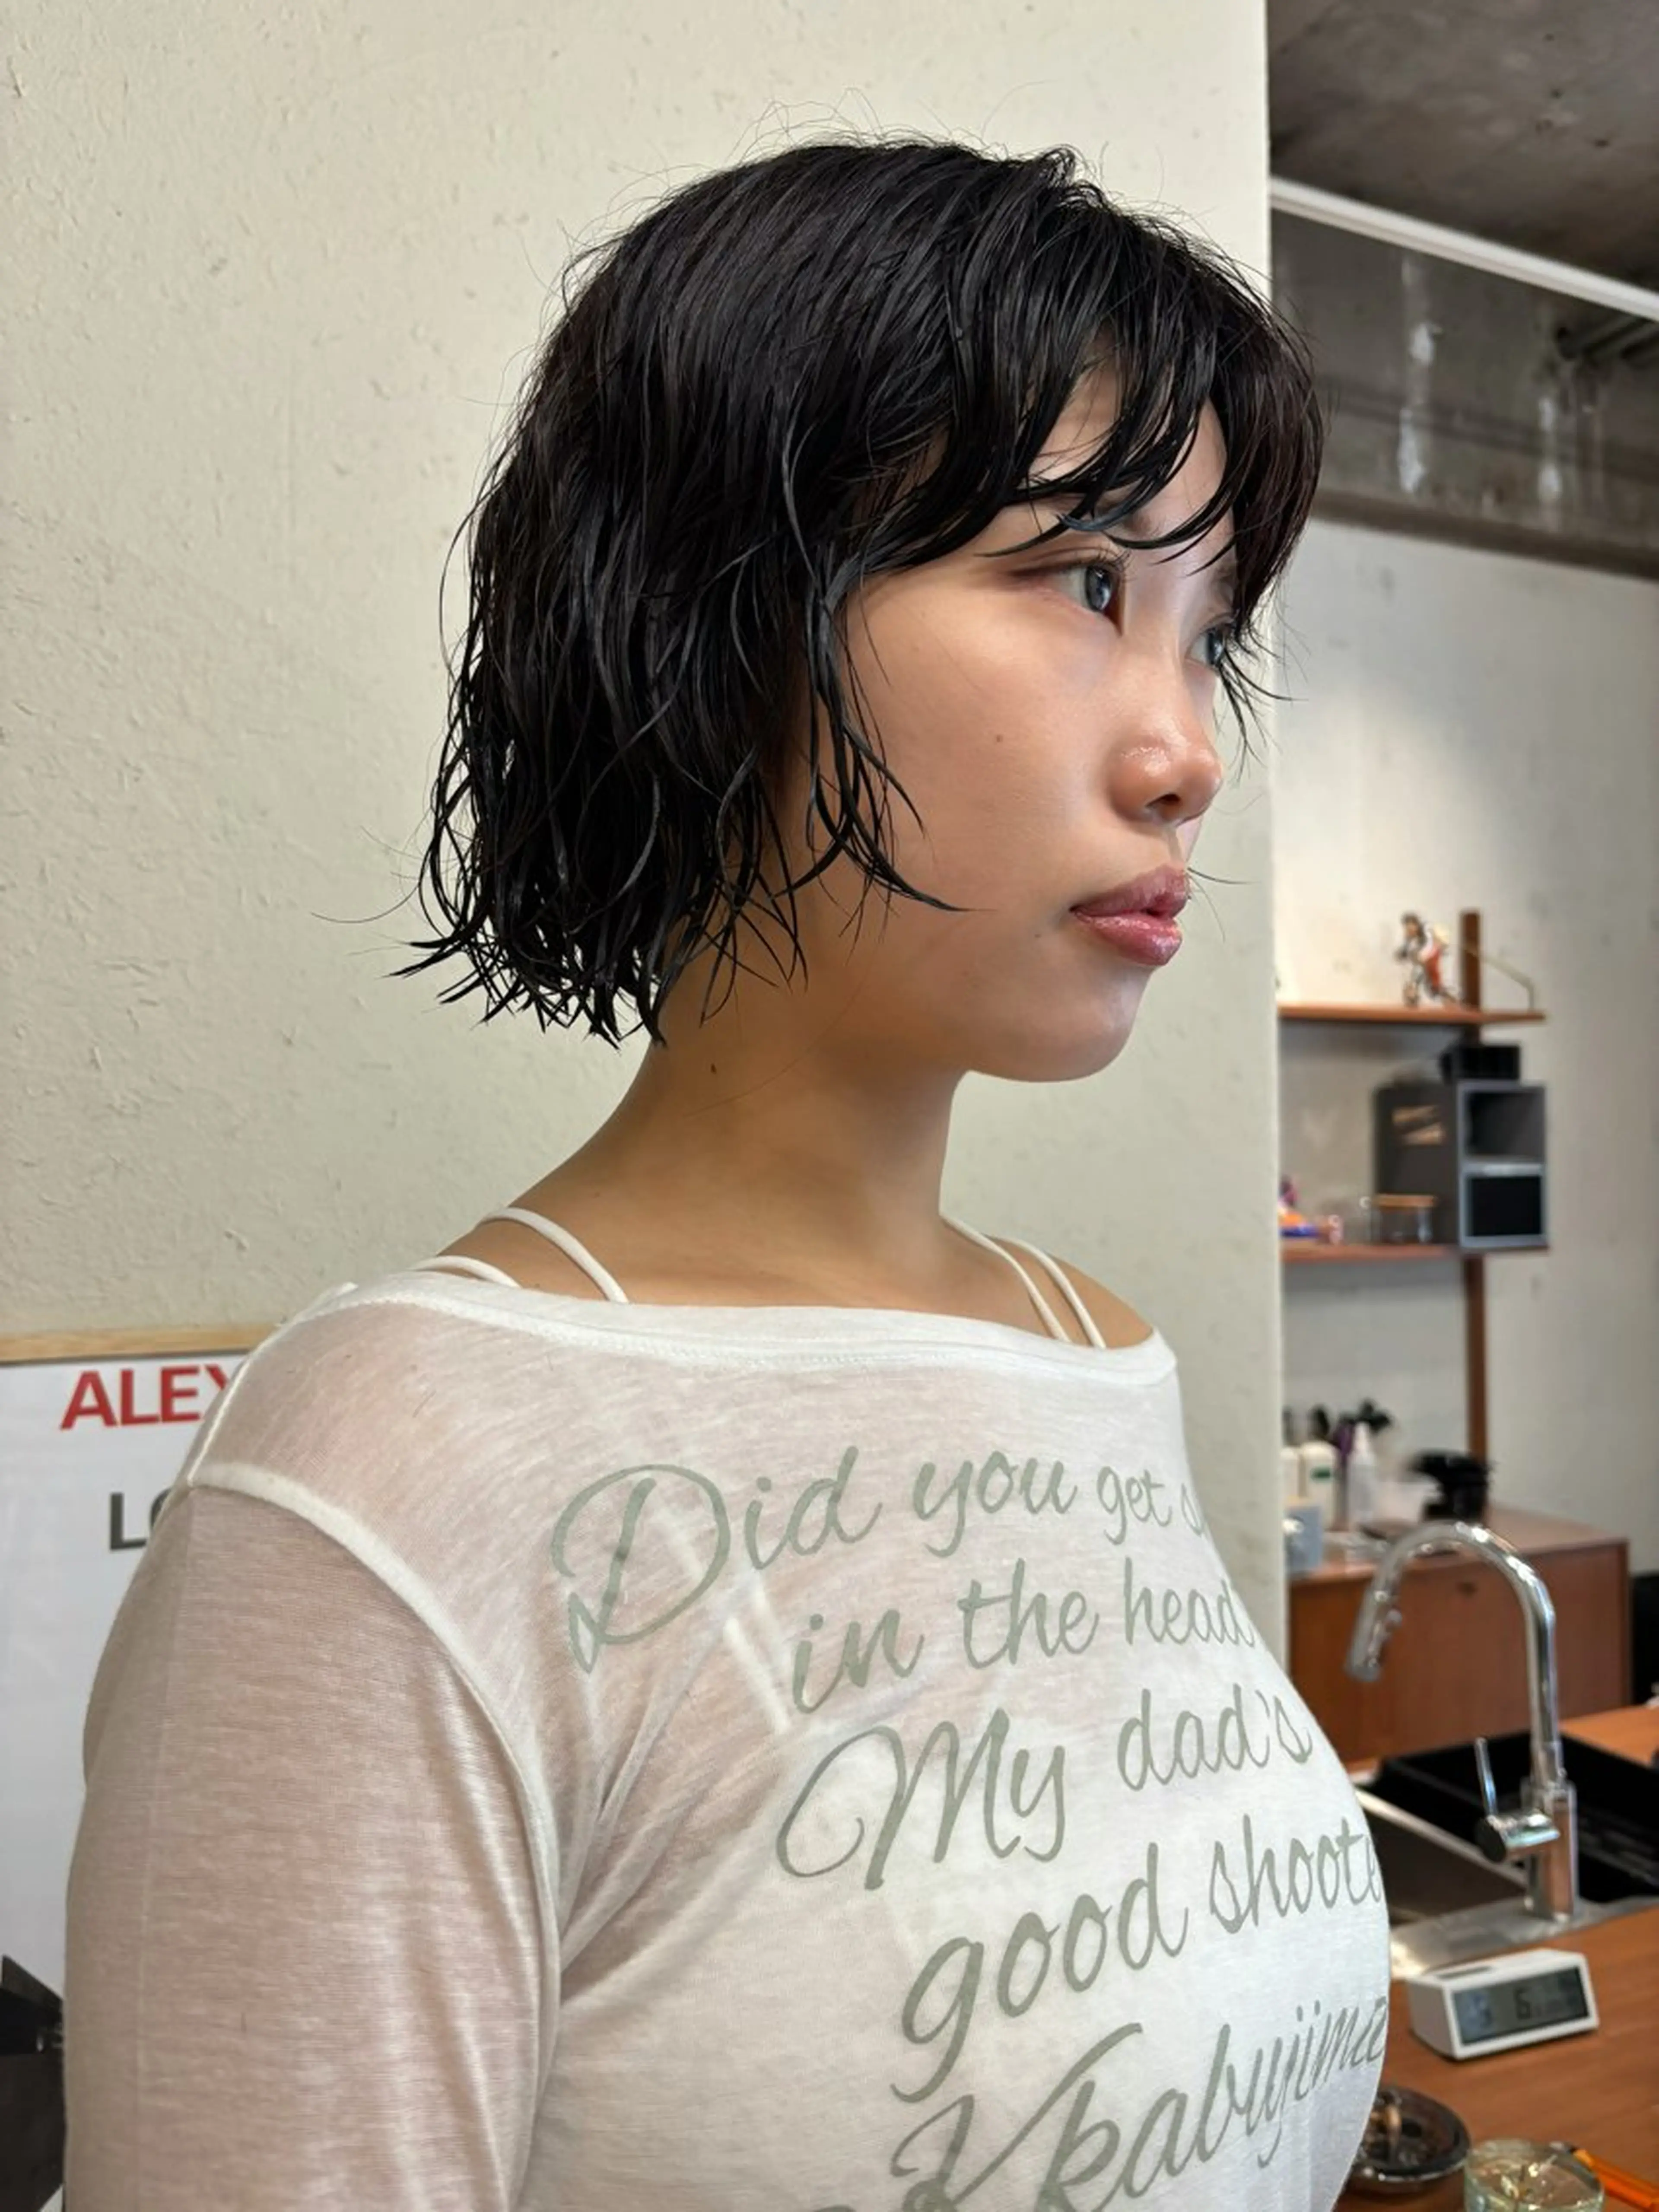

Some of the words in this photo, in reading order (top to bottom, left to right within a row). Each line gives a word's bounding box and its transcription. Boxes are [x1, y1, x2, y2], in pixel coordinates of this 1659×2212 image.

[551, 1446, 882, 1674] Did
[913, 1450, 1078, 1559] you
[1096, 1466, 1172, 1545] get
[792, 1609, 925, 1714] in
[957, 1557, 1100, 1669] the
[1124, 1556, 1255, 1649] head
[778, 1708, 1066, 1891] My
[1118, 1683, 1313, 1791] dad's
[891, 1843, 1188, 2103] good
